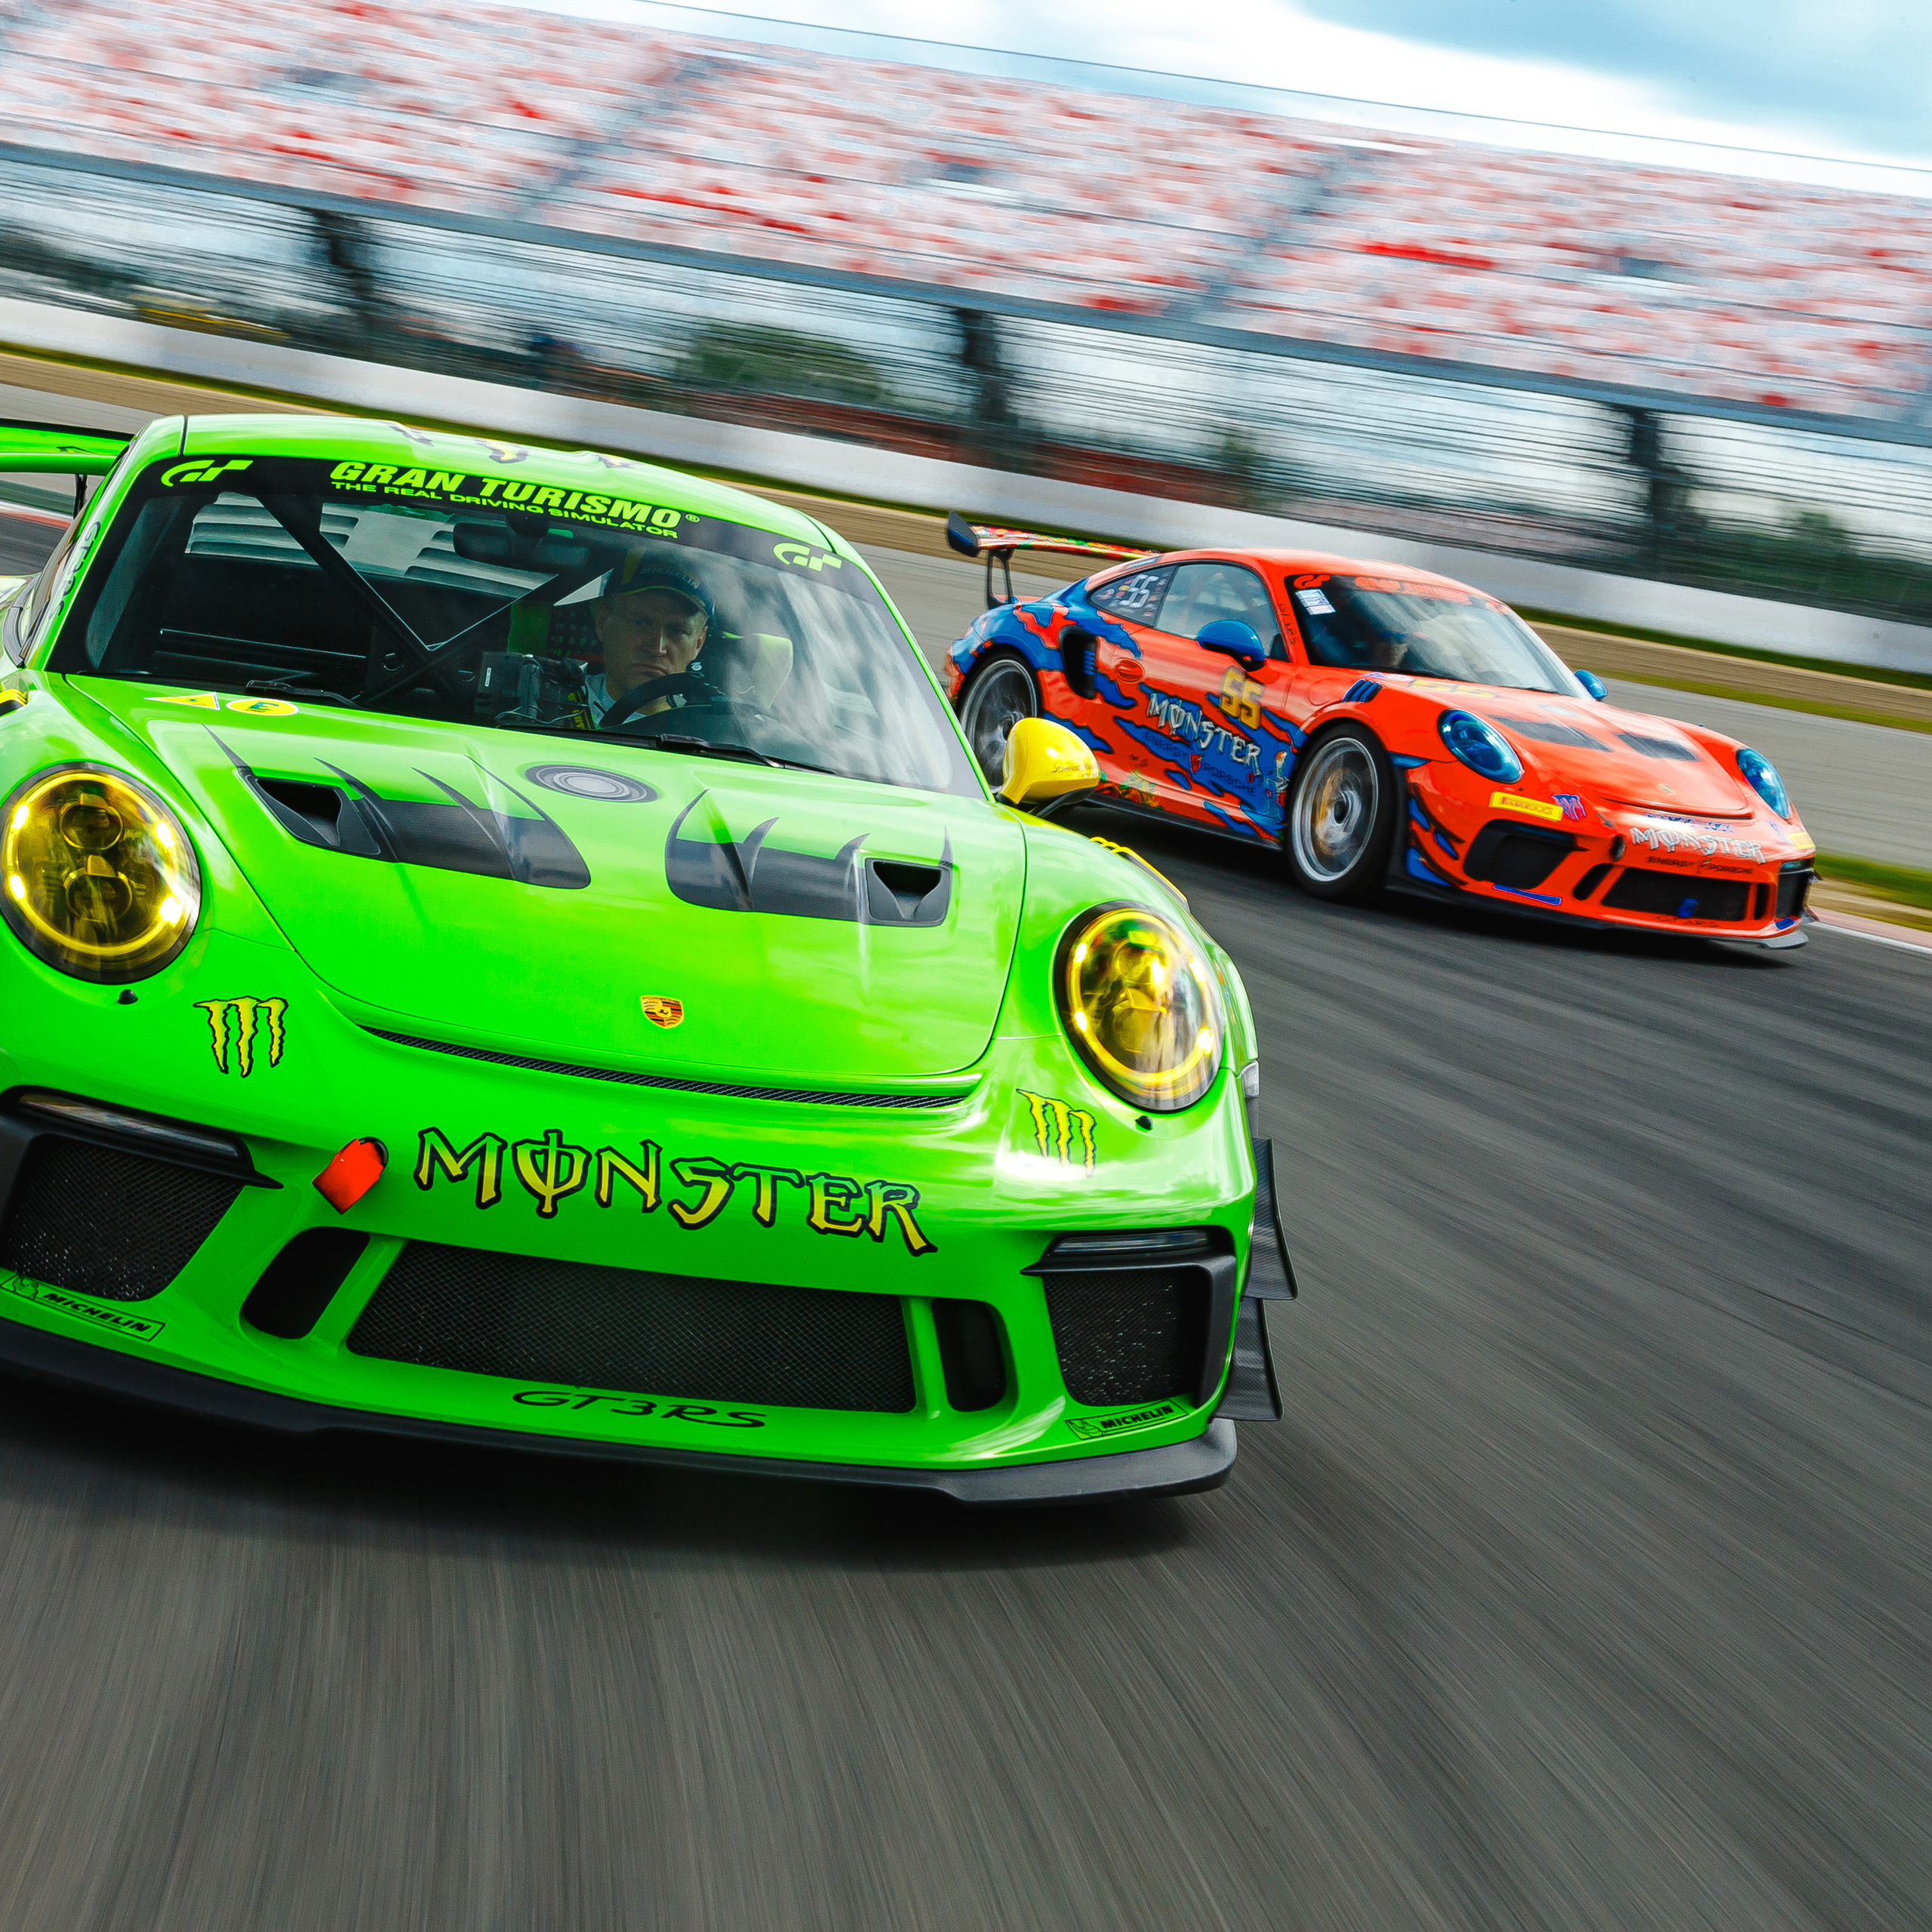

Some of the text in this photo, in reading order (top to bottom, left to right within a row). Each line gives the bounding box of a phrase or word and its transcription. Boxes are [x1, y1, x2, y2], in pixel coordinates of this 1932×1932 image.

[330, 461, 466, 492] GRAN
[331, 481, 678, 539] THE REAL DRIVING SIMULATOR
[1118, 574, 1160, 608] 55
[1219, 666, 1266, 731] 55
[1146, 692, 1262, 776] MONSTER
[1629, 826, 1767, 866] MONSTER
[417, 1128, 939, 1257] MONSTER
[43, 1291, 152, 1333] MICHELIN
[1100, 1404, 1175, 1429] MICHELIN
